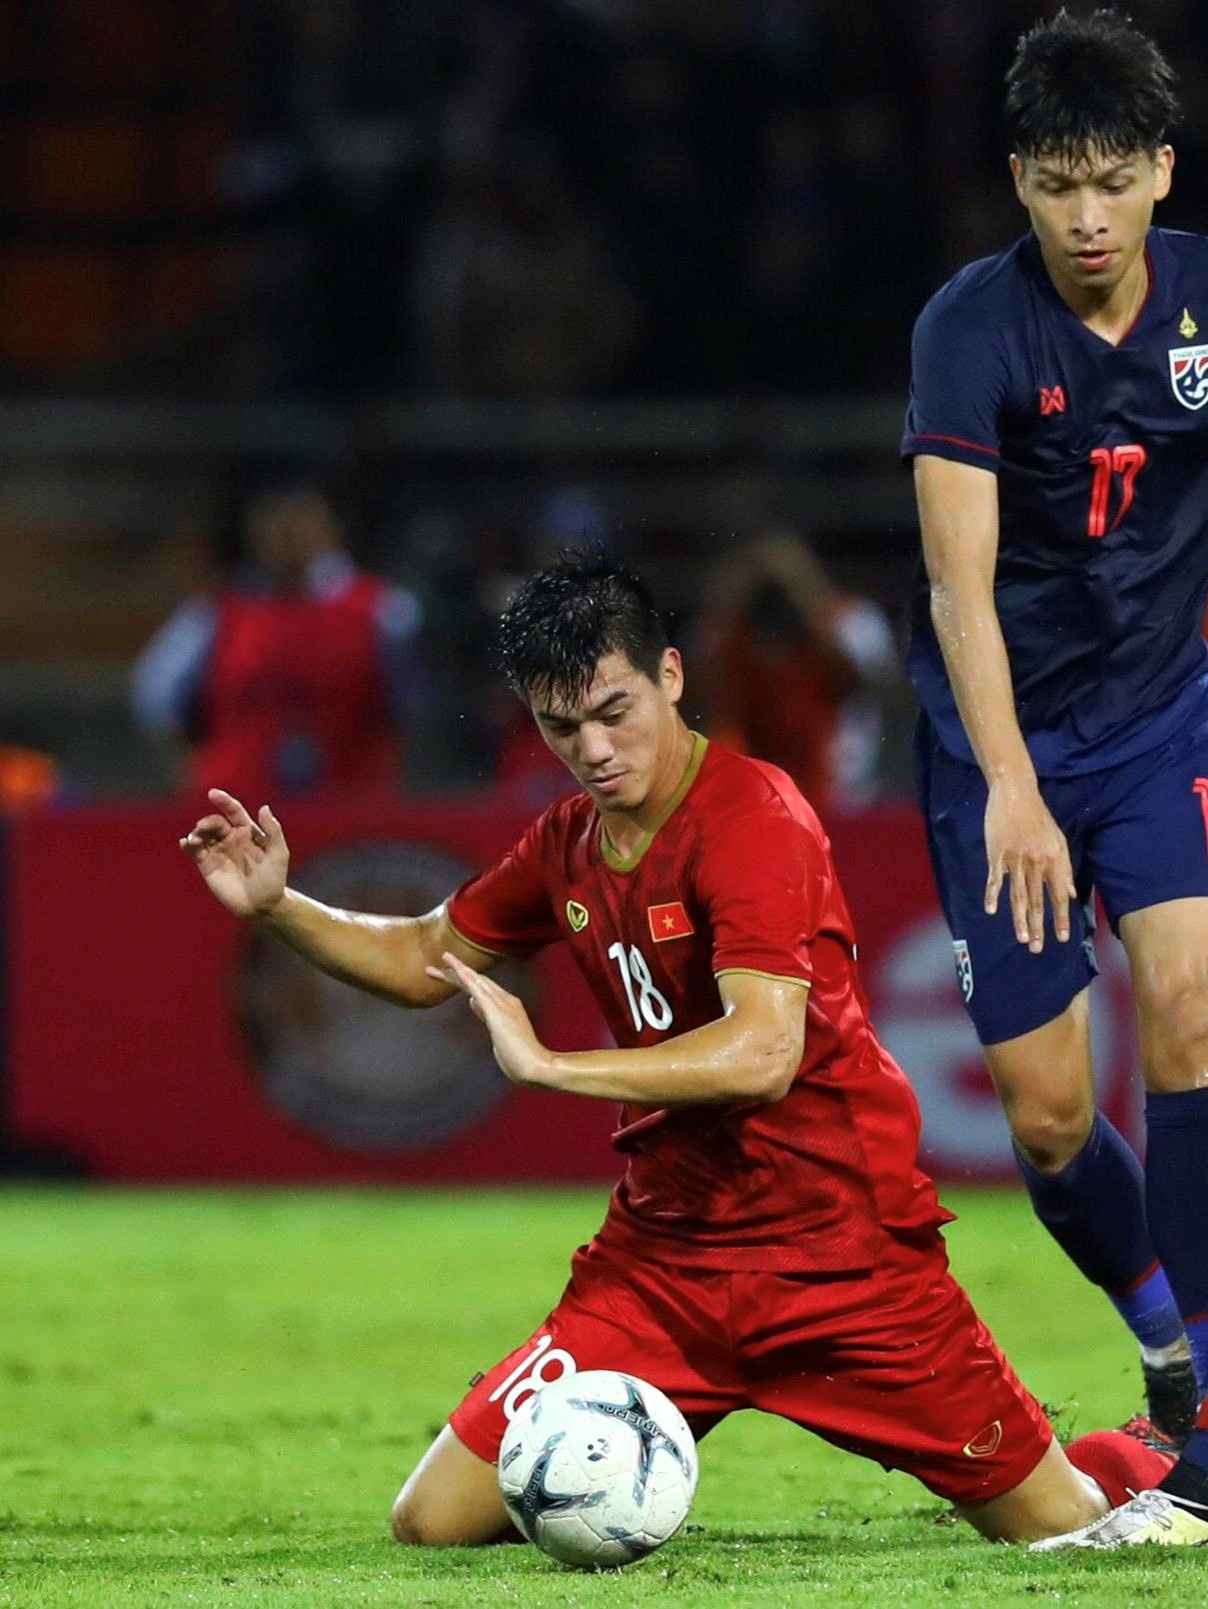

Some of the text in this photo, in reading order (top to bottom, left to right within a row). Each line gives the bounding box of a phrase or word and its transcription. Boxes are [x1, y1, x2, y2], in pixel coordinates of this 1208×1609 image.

[1088, 444, 1147, 537] 17
[608, 941, 673, 1032] 18
[489, 1334, 577, 1421] 18
